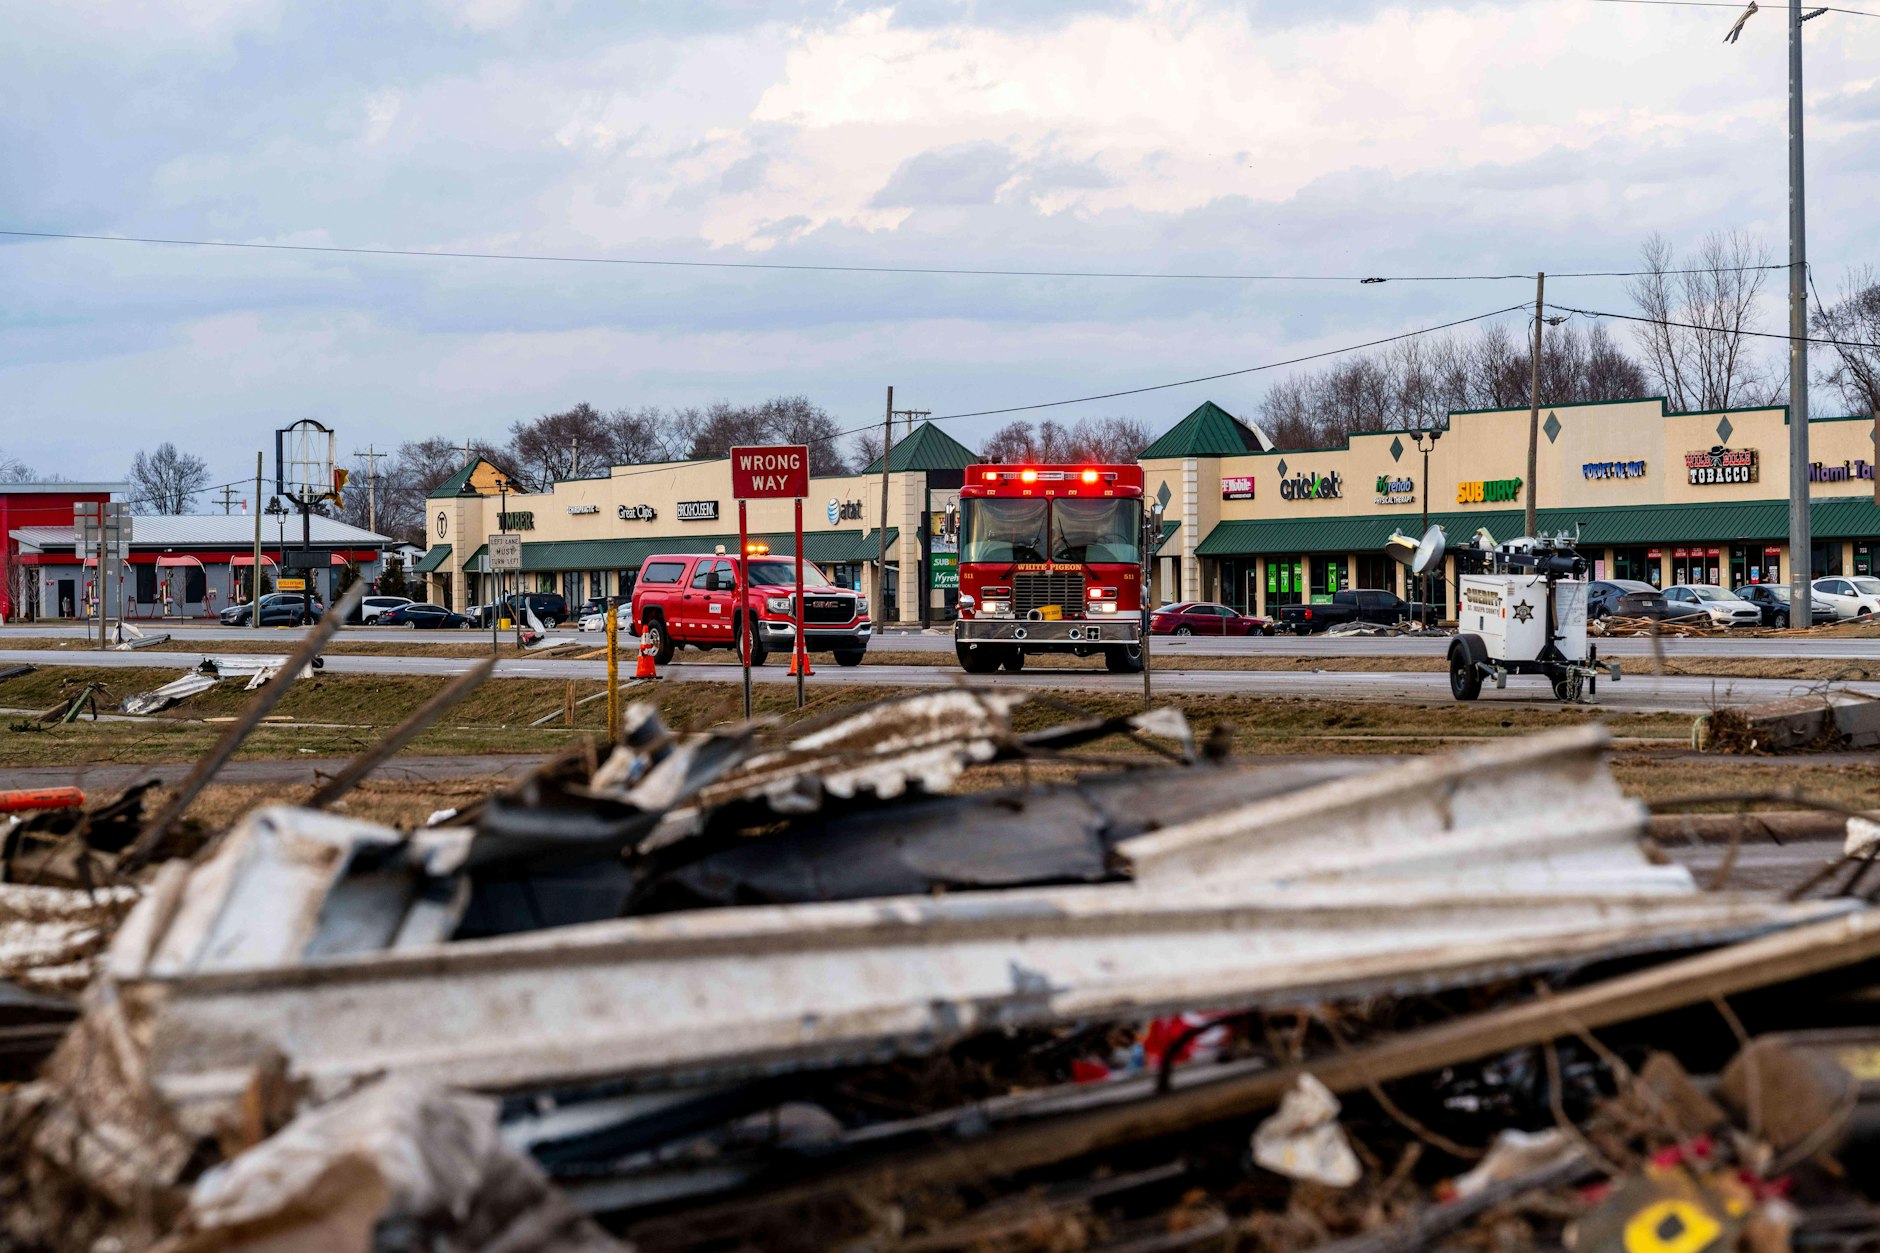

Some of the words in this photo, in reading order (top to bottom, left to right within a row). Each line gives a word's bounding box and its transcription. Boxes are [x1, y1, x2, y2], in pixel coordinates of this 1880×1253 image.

[739, 454, 800, 471] WRONG
[1685, 453, 1711, 467] WILD
[1582, 462, 1613, 479] FORGET
[1613, 462, 1627, 479] ME
[1627, 461, 1646, 477] NOT
[1690, 466, 1749, 484] TOBACCO
[752, 475, 788, 491] WAY
[1280, 471, 1341, 500] cricket
[1457, 477, 1523, 504] SUBWAY
[1394, 496, 1413, 504] THERAPY
[617, 505, 636, 520] Great
[636, 504, 653, 522] Clips
[496, 512, 535, 532] TMBER
[506, 557, 519, 565] LEFT
[933, 558, 957, 566] SUBW
[1050, 563, 1082, 571] PIGEON
[812, 600, 838, 608] GMC
[1465, 587, 1502, 607] SHERIFF
